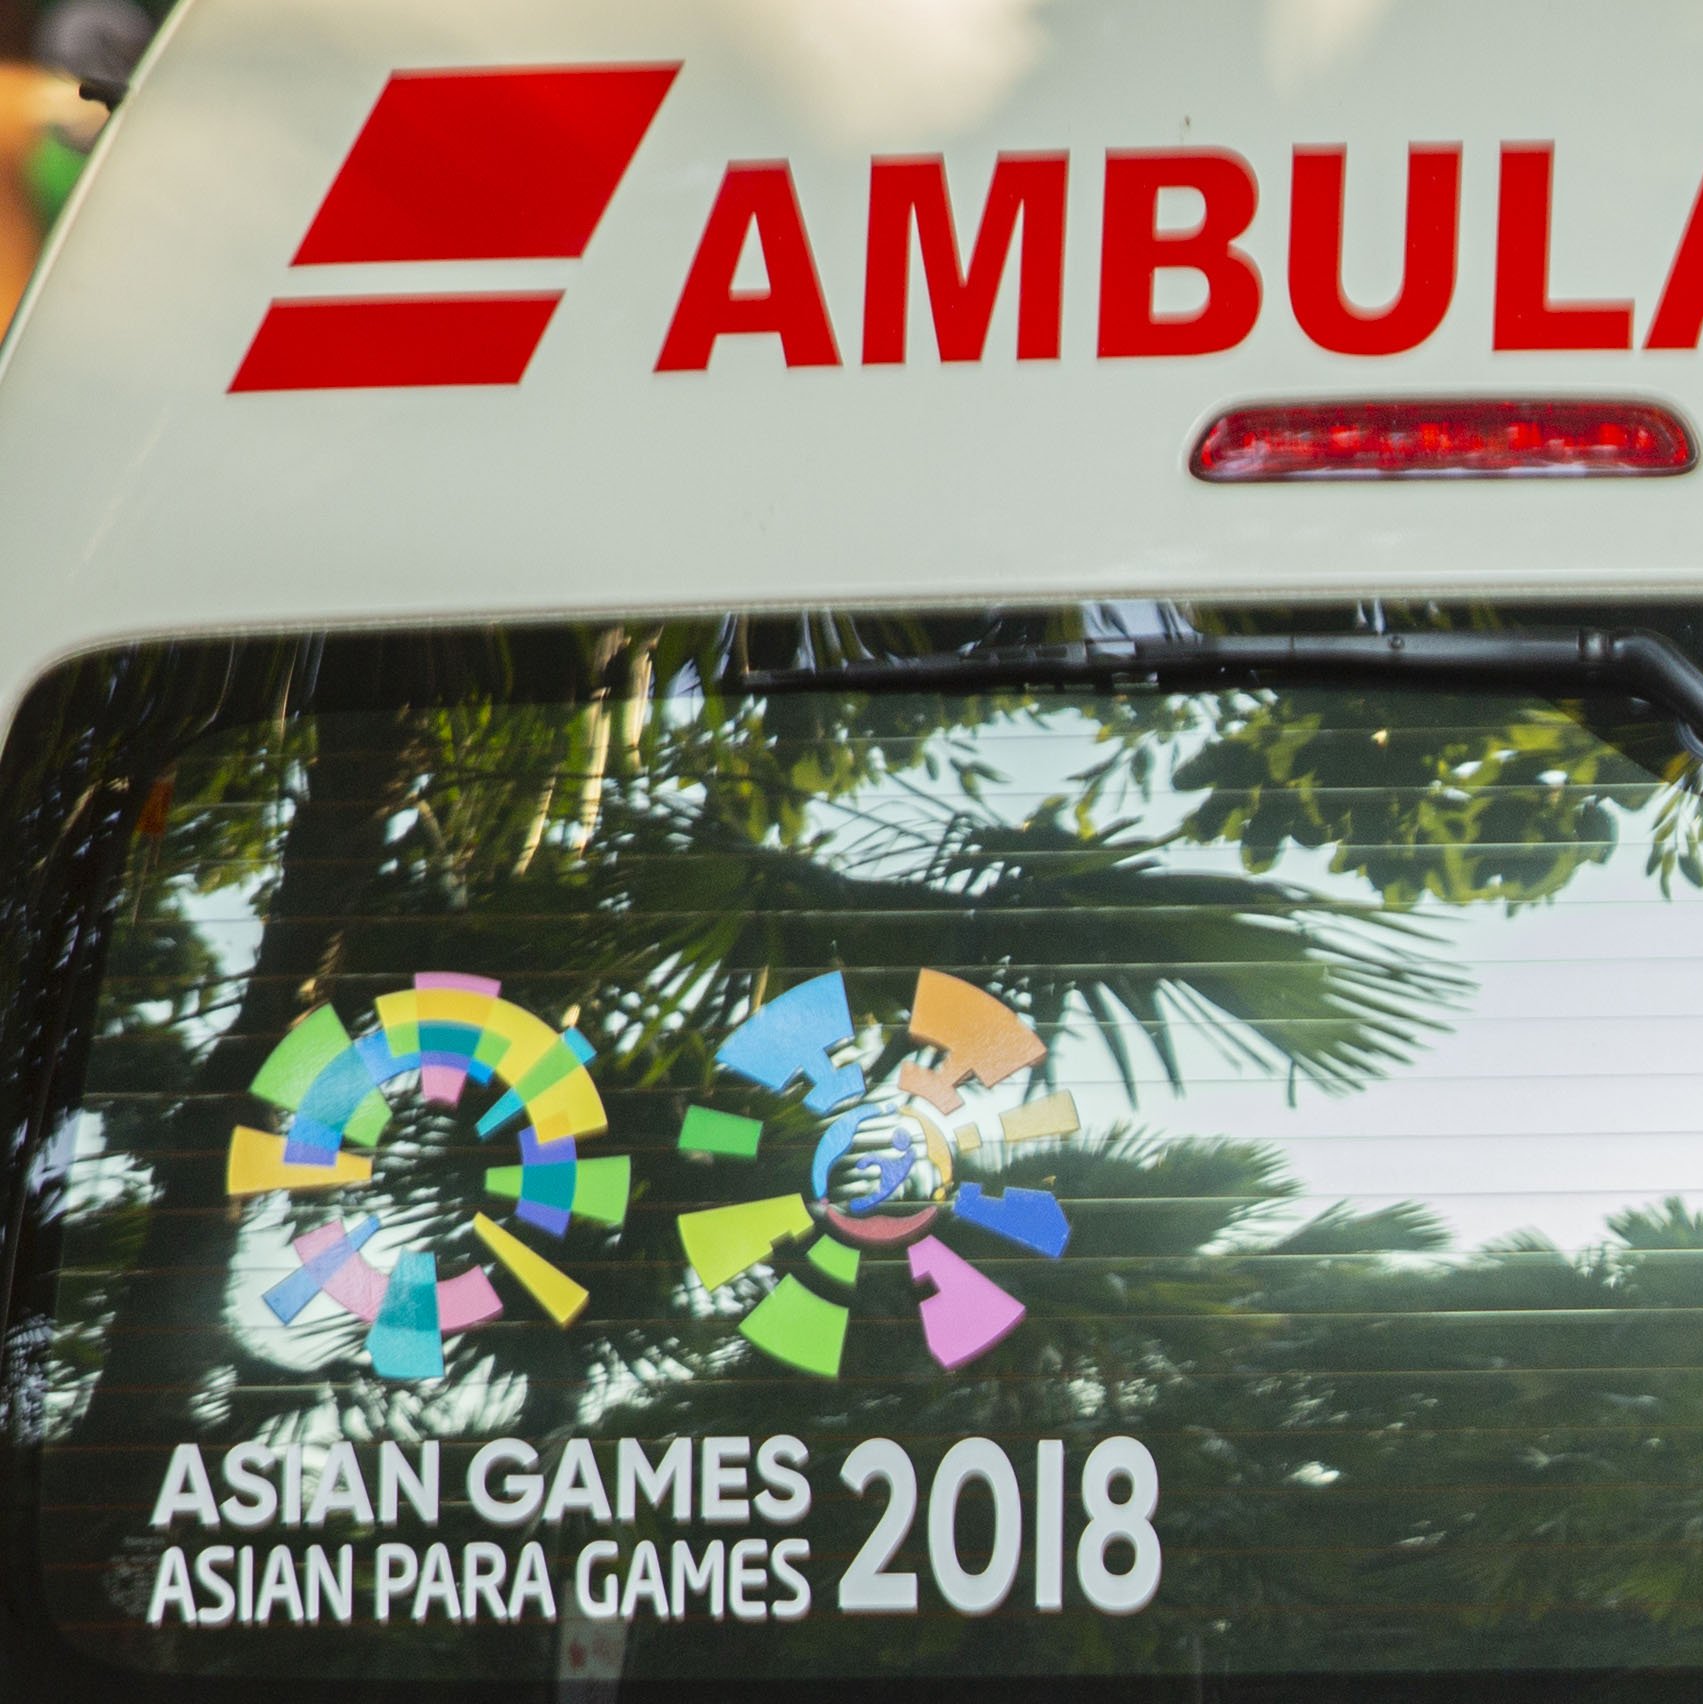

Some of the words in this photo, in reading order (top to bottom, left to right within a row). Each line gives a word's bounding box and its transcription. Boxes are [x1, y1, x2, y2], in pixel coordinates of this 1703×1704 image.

[150, 1439, 441, 1527] ASIAN
[466, 1433, 812, 1526] GAMES
[838, 1436, 1163, 1616] 2018
[148, 1542, 354, 1625] ASIAN
[385, 1539, 556, 1623] PARA
[575, 1536, 812, 1621] GAMES
